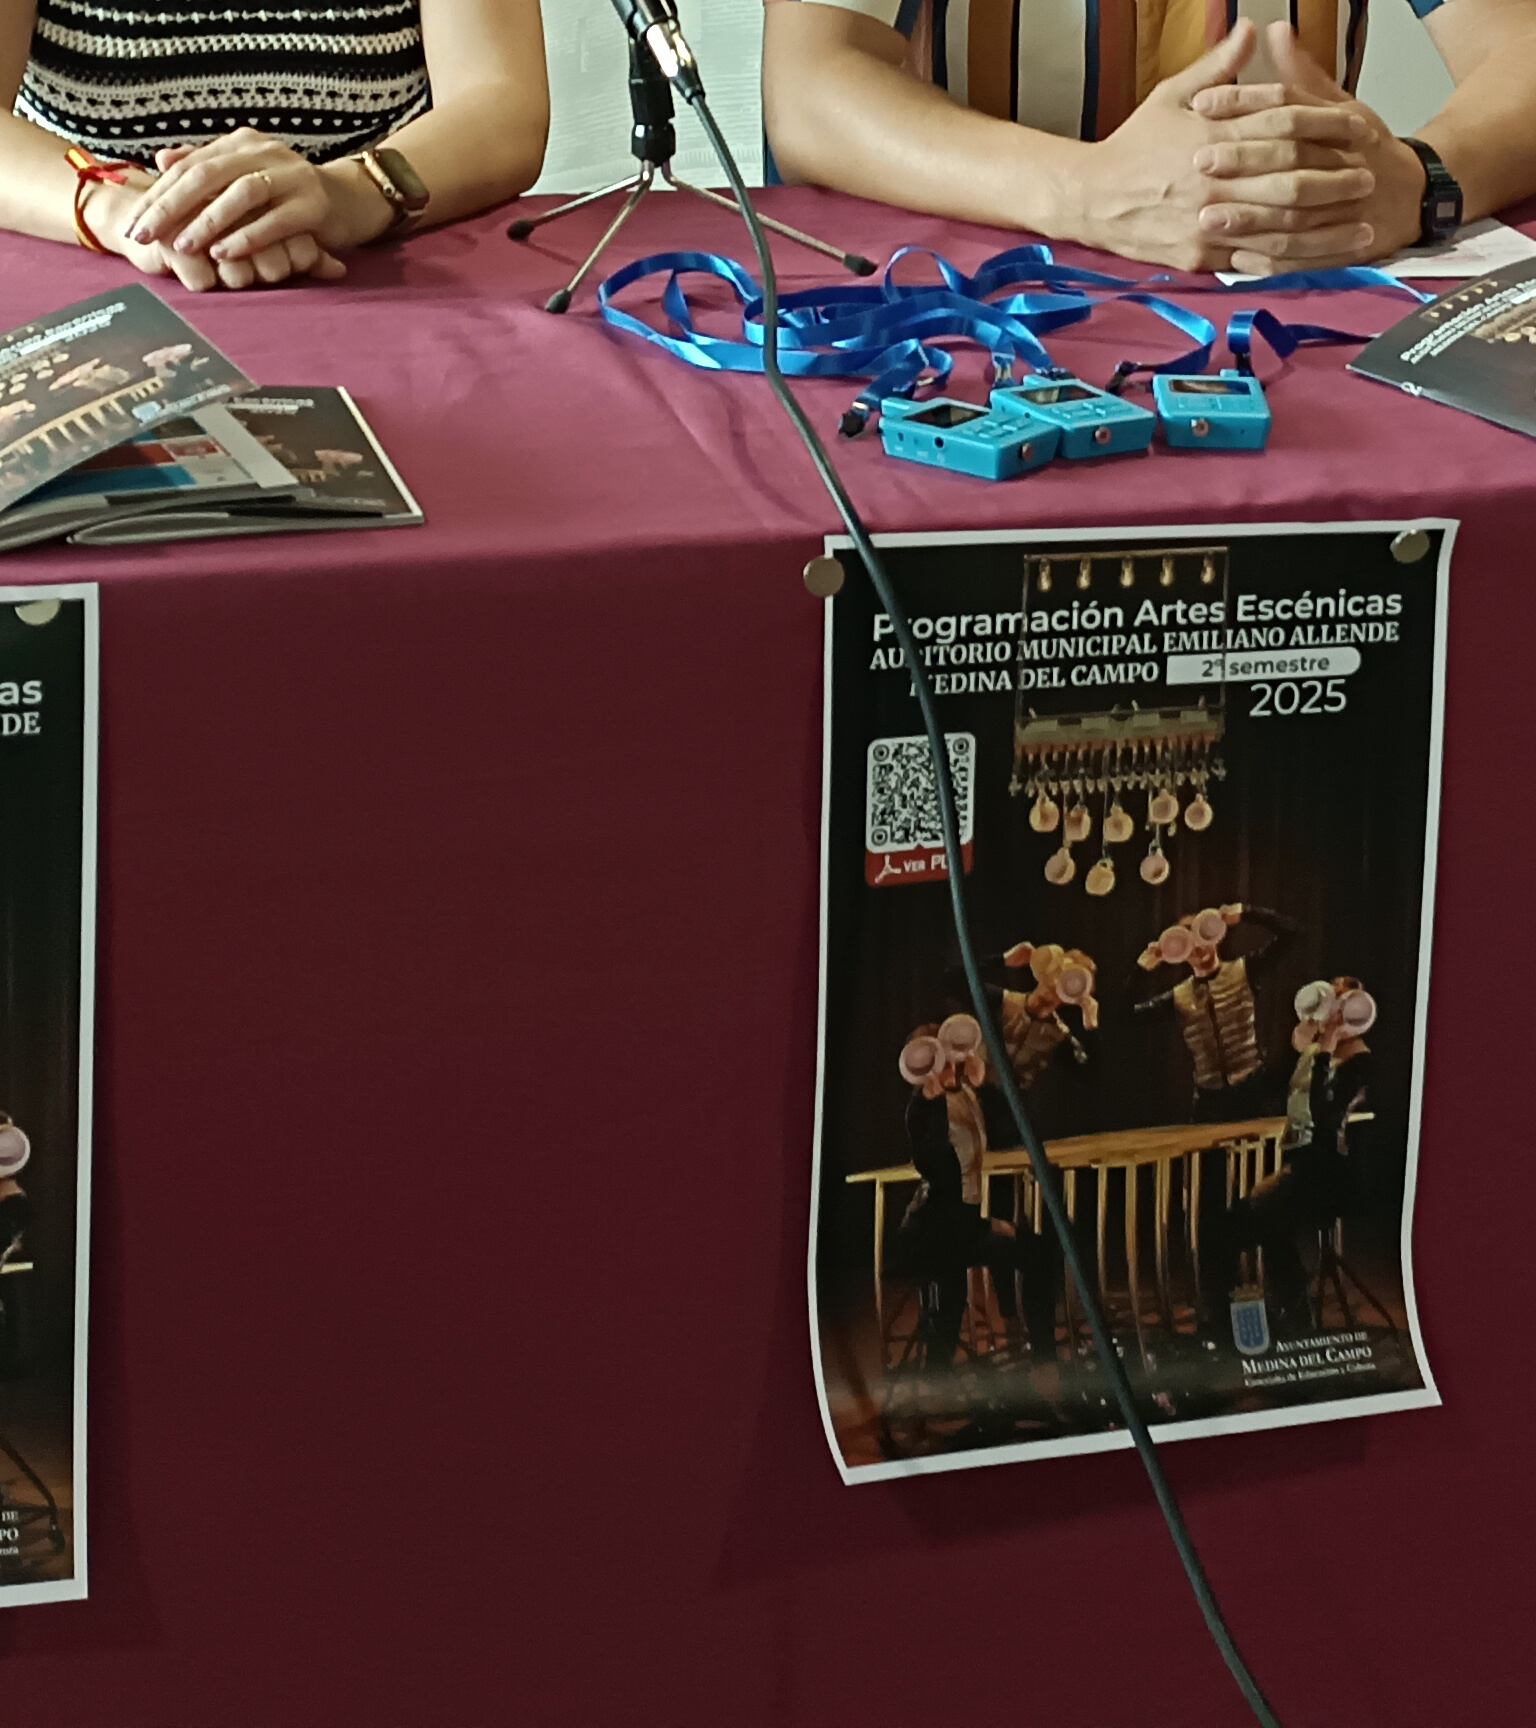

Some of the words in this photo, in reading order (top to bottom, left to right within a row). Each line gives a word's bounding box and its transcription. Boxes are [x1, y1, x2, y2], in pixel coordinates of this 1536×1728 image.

[873, 600, 1124, 644] Pogramación
[1133, 599, 1225, 626] Artes
[1236, 588, 1402, 622] Escénicas
[869, 641, 1011, 670] AUITORIO
[1016, 632, 1157, 661] MUNICIPAL
[1164, 627, 1285, 652] EMILIANO
[1289, 622, 1400, 646] ALLENDE
[910, 669, 1012, 697] EDINA
[1018, 667, 1065, 689] DEL
[1070, 661, 1159, 687] CAMPO
[1229, 655, 1330, 675] semestre
[1249, 679, 1347, 716] 2025
[1326, 1346, 1372, 1363] CAMPO
